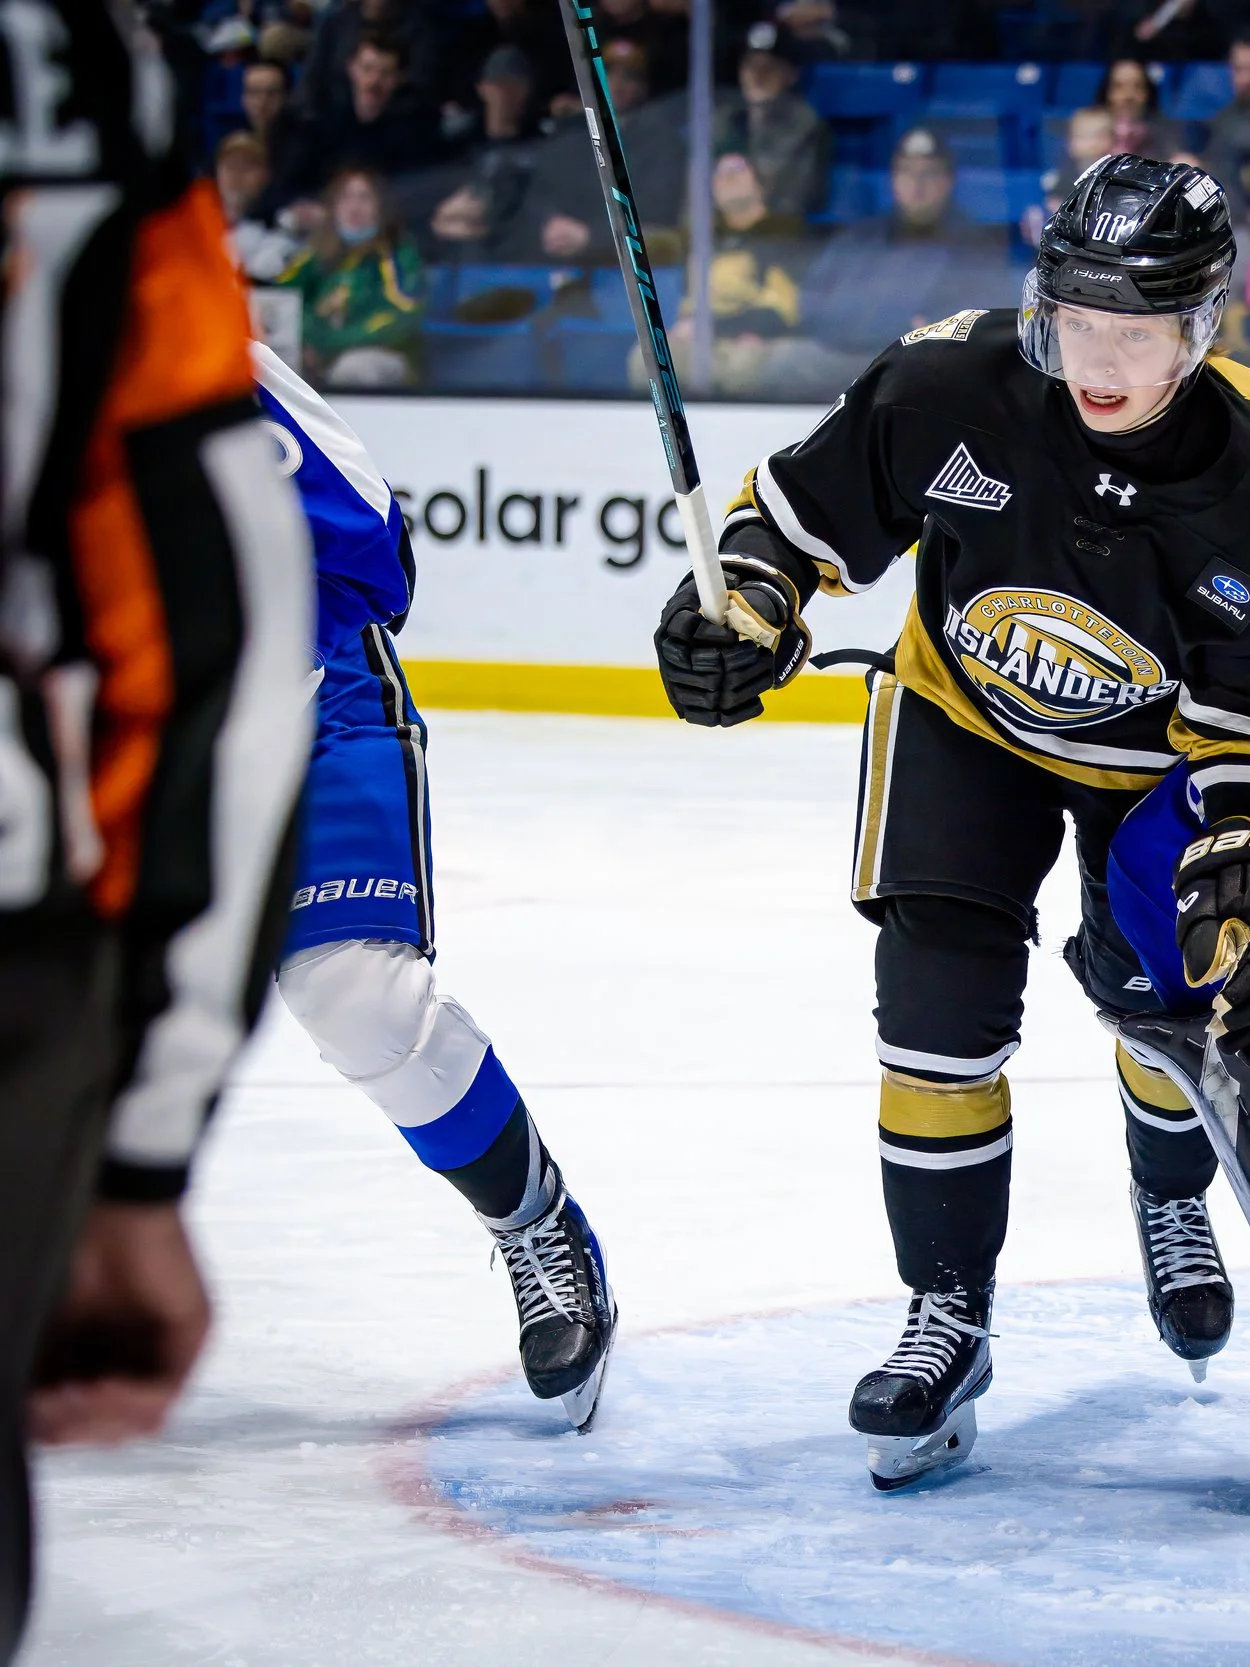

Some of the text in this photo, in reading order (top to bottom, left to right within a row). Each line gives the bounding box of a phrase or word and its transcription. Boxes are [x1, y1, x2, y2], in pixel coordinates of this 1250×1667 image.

[1091, 211, 1127, 244] 11
[1196, 585, 1247, 621] SUBARU
[980, 595, 1155, 677] CHARLOTTETOWN
[778, 638, 805, 682] BAUER
[945, 608, 1180, 706] ISLANDERS
[290, 877, 419, 912] BAUER
